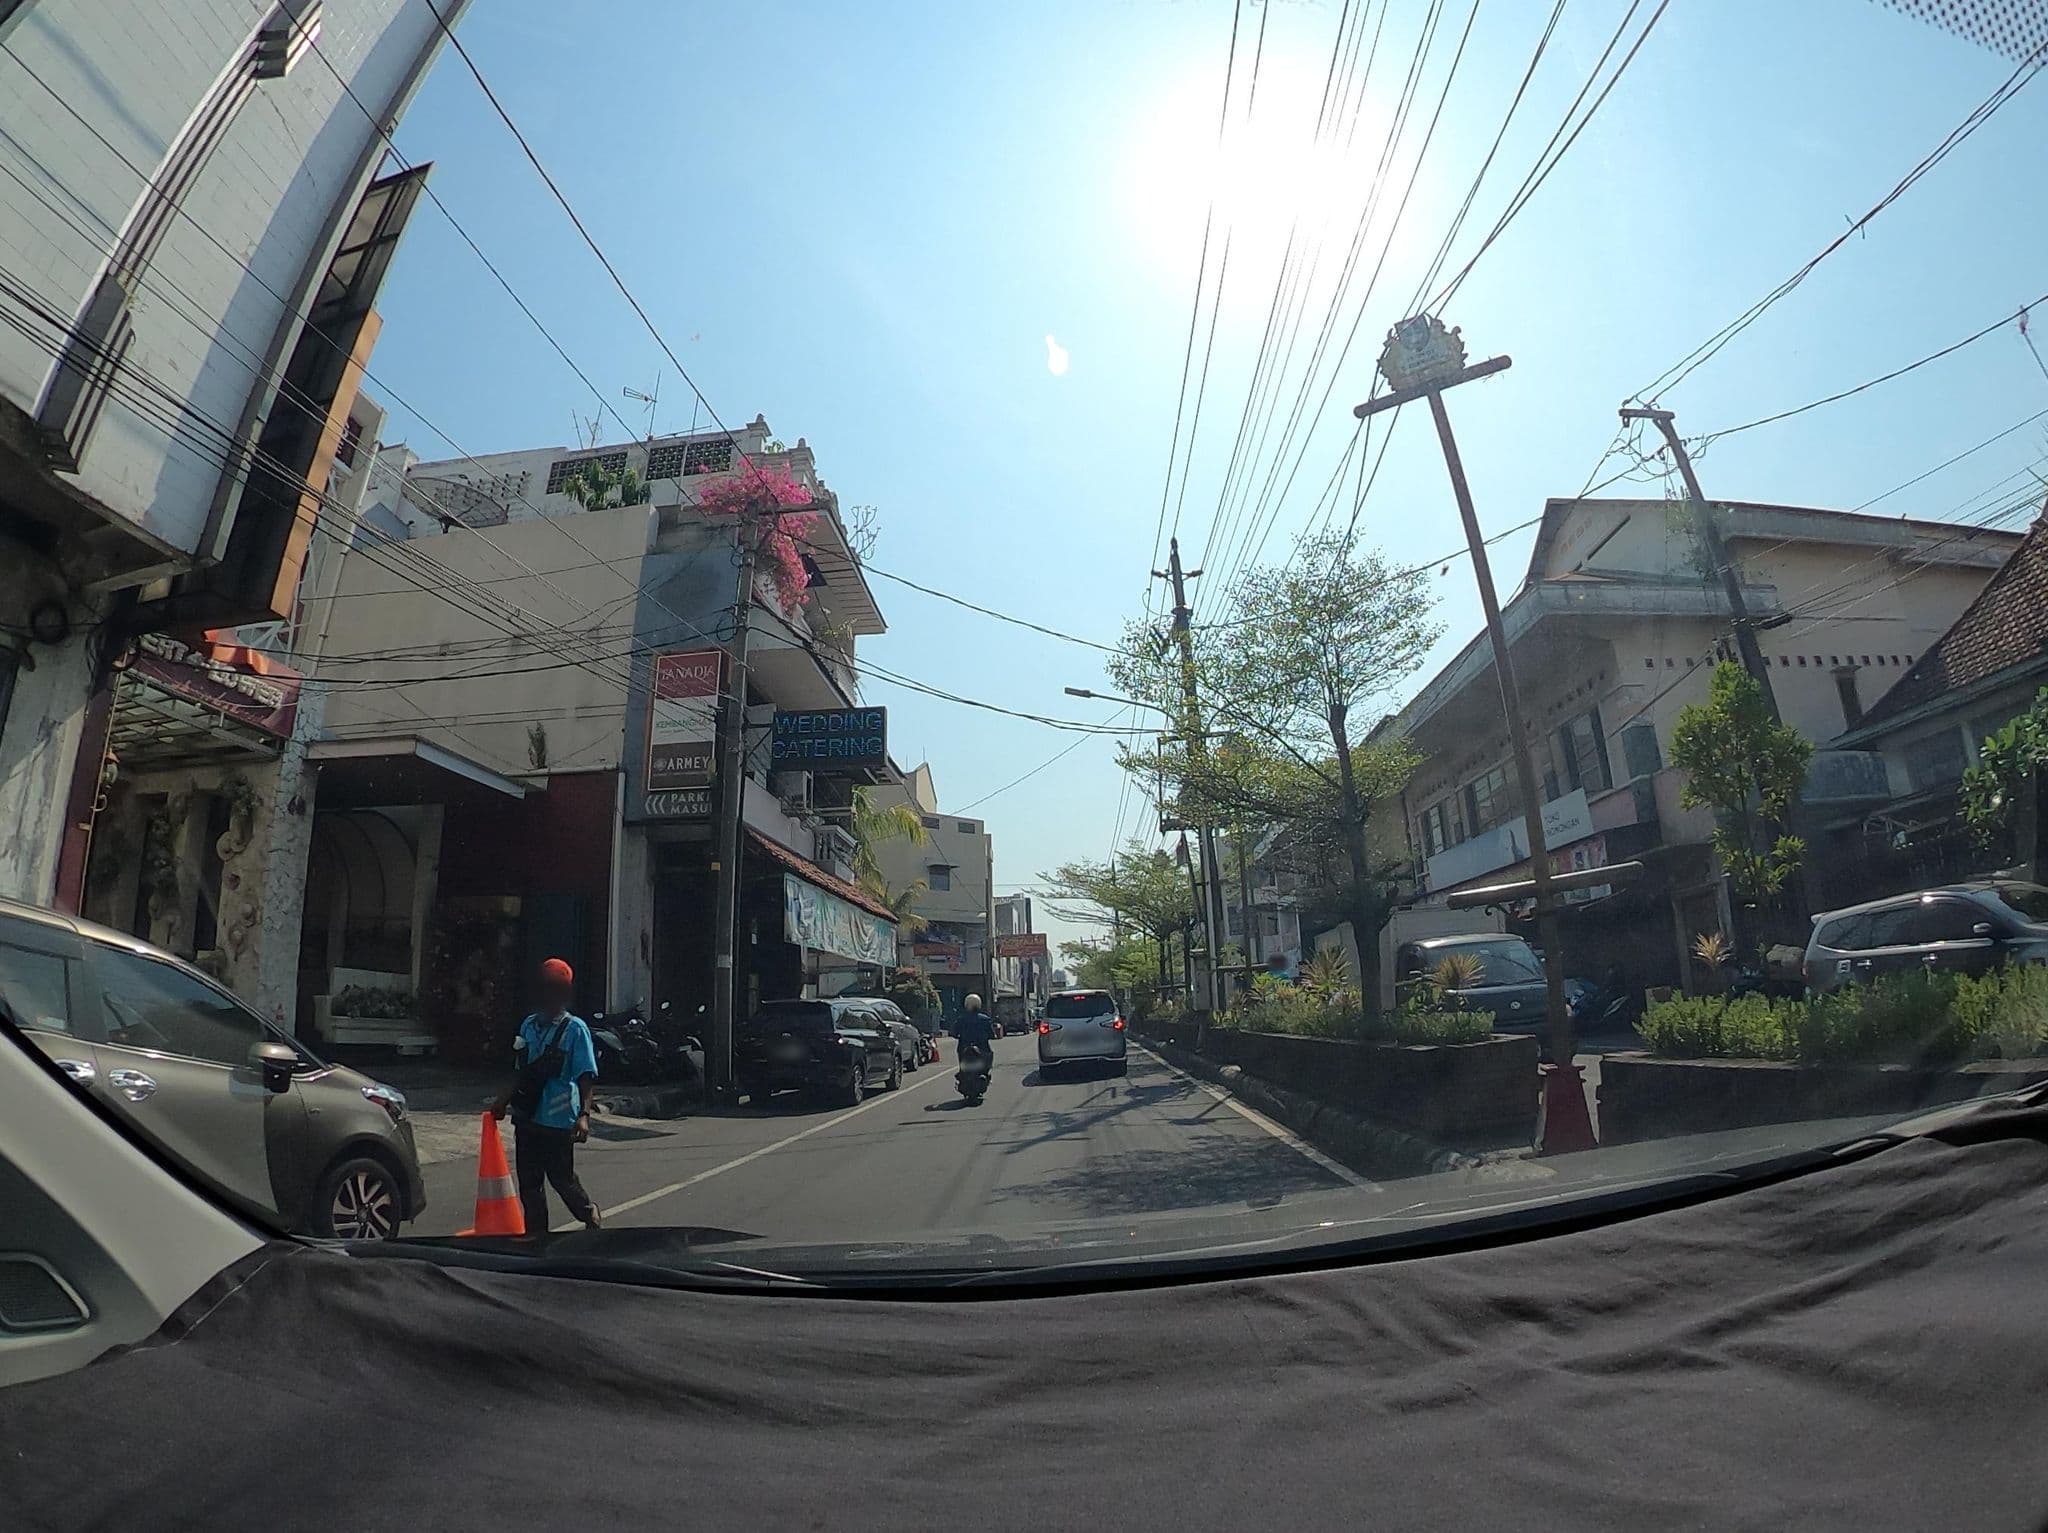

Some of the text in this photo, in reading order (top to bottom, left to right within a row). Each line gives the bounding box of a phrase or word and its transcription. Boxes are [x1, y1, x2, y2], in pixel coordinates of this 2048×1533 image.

[775, 712, 882, 734] WEDDING
[772, 736, 882, 758] CATERING
[667, 756, 710, 770] ARMEY
